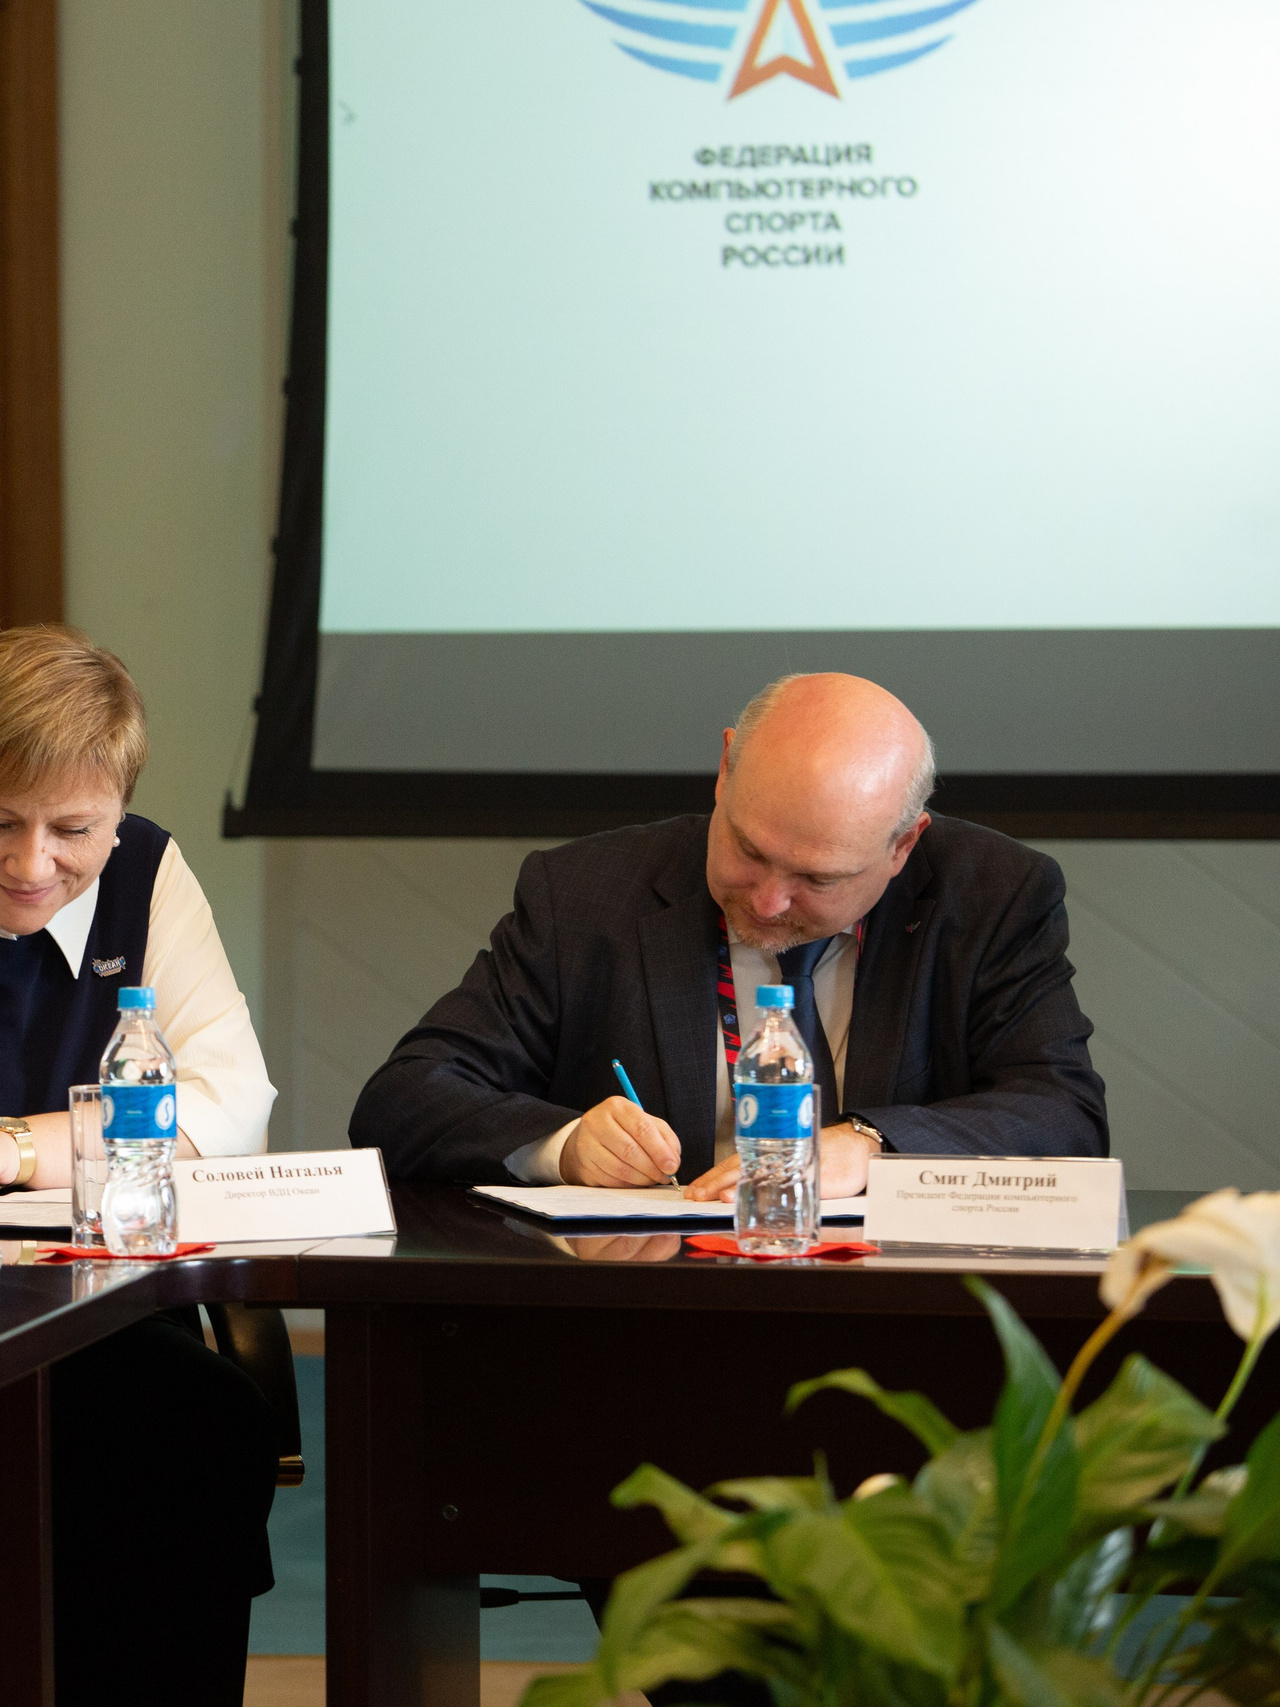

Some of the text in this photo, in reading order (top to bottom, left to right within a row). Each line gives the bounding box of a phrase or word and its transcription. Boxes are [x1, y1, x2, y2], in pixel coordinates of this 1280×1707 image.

[693, 143, 873, 169] ФЕДЕРАЦИЯ
[649, 176, 919, 202] КОМПЬЮТЕРНОГО
[724, 211, 842, 235] СПОРТА
[721, 245, 845, 268] РОССИИ
[192, 1164, 344, 1183] Соловей Наталья
[919, 1170, 1058, 1190] Смит Дмитрий
[224, 1190, 267, 1200] Директор
[292, 1187, 320, 1196] Океан
[896, 1190, 1078, 1203] Президент Федерации компьютерного
[951, 1204, 1020, 1213] спорта России
